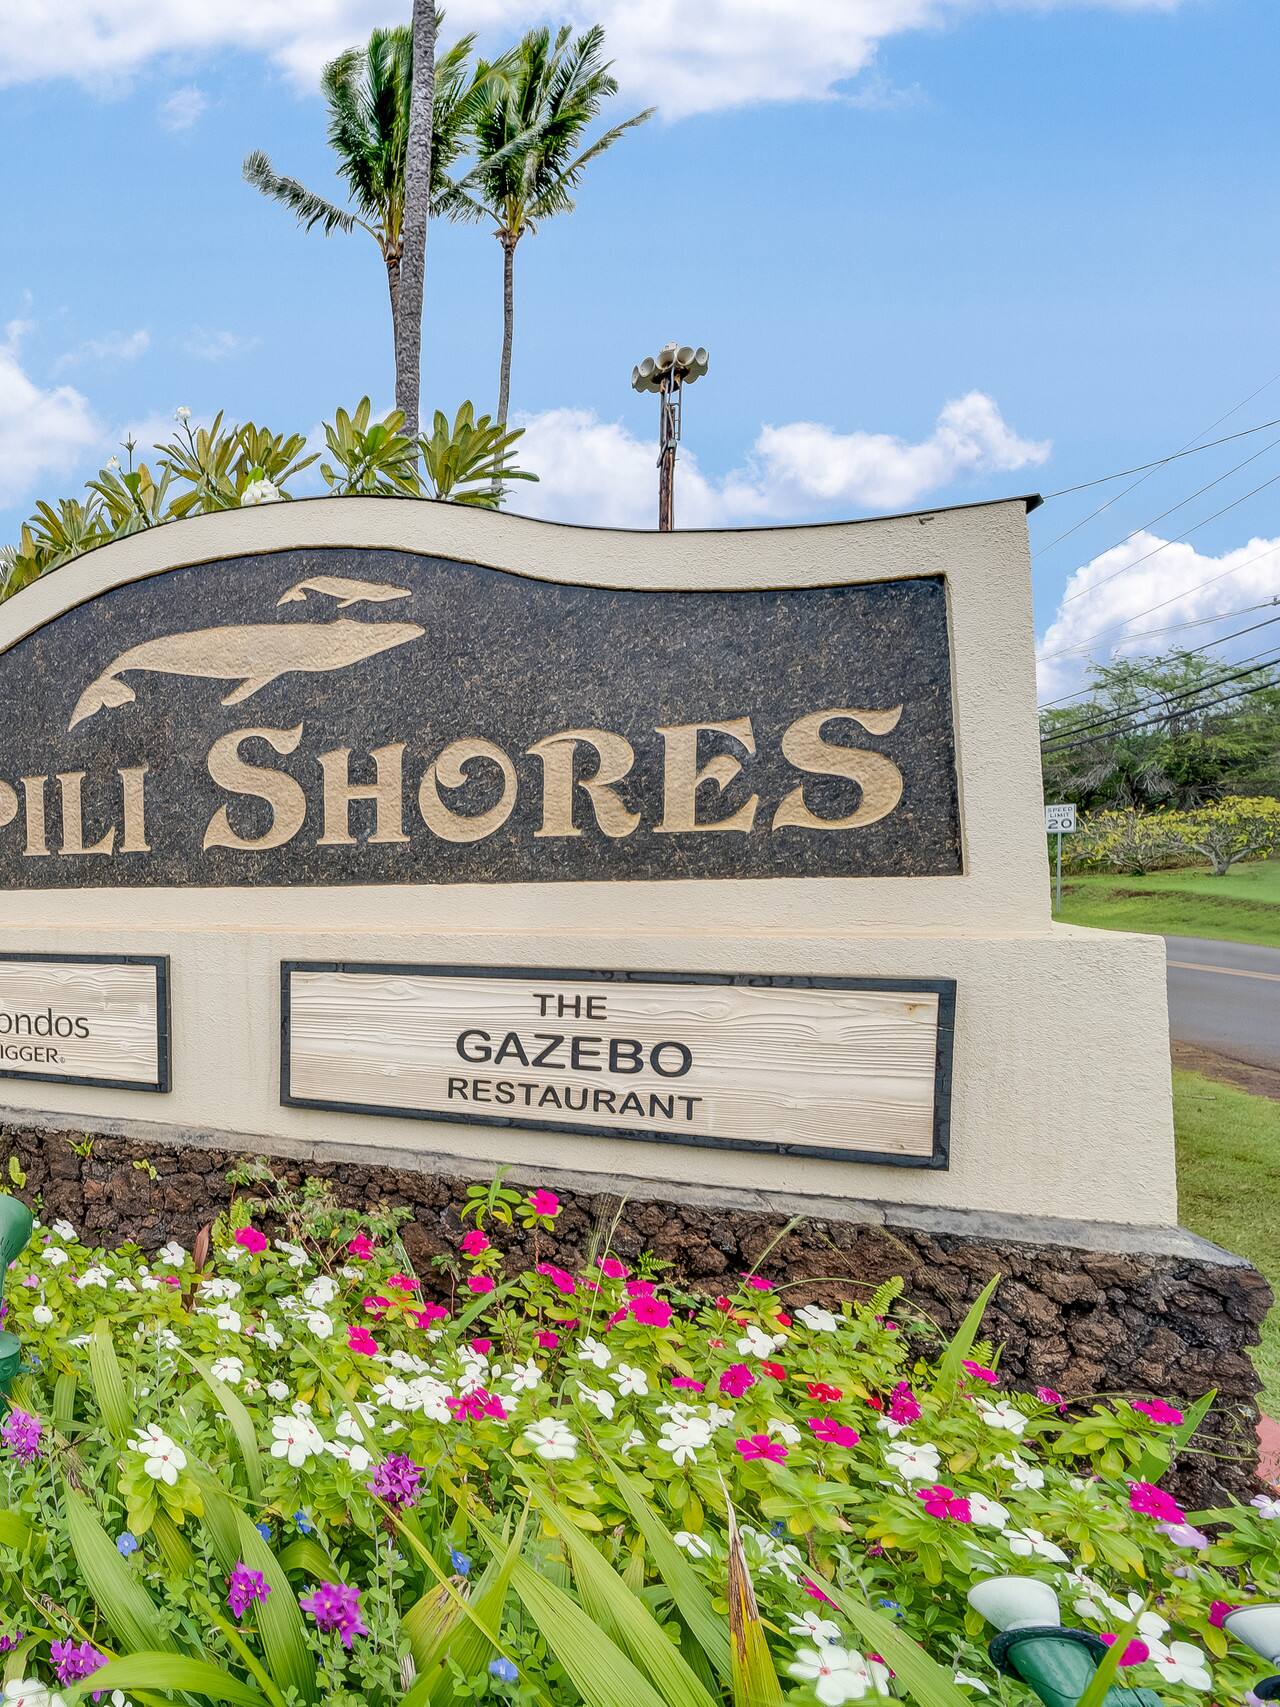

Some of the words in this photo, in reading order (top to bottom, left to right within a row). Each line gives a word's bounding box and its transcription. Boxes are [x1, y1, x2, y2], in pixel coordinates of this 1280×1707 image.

[203, 703, 903, 851] SHORES
[1047, 818, 1072, 830] 20
[532, 993, 608, 1020] THE
[456, 1029, 693, 1078] GAZEBO
[447, 1077, 703, 1121] RESTAURANT
